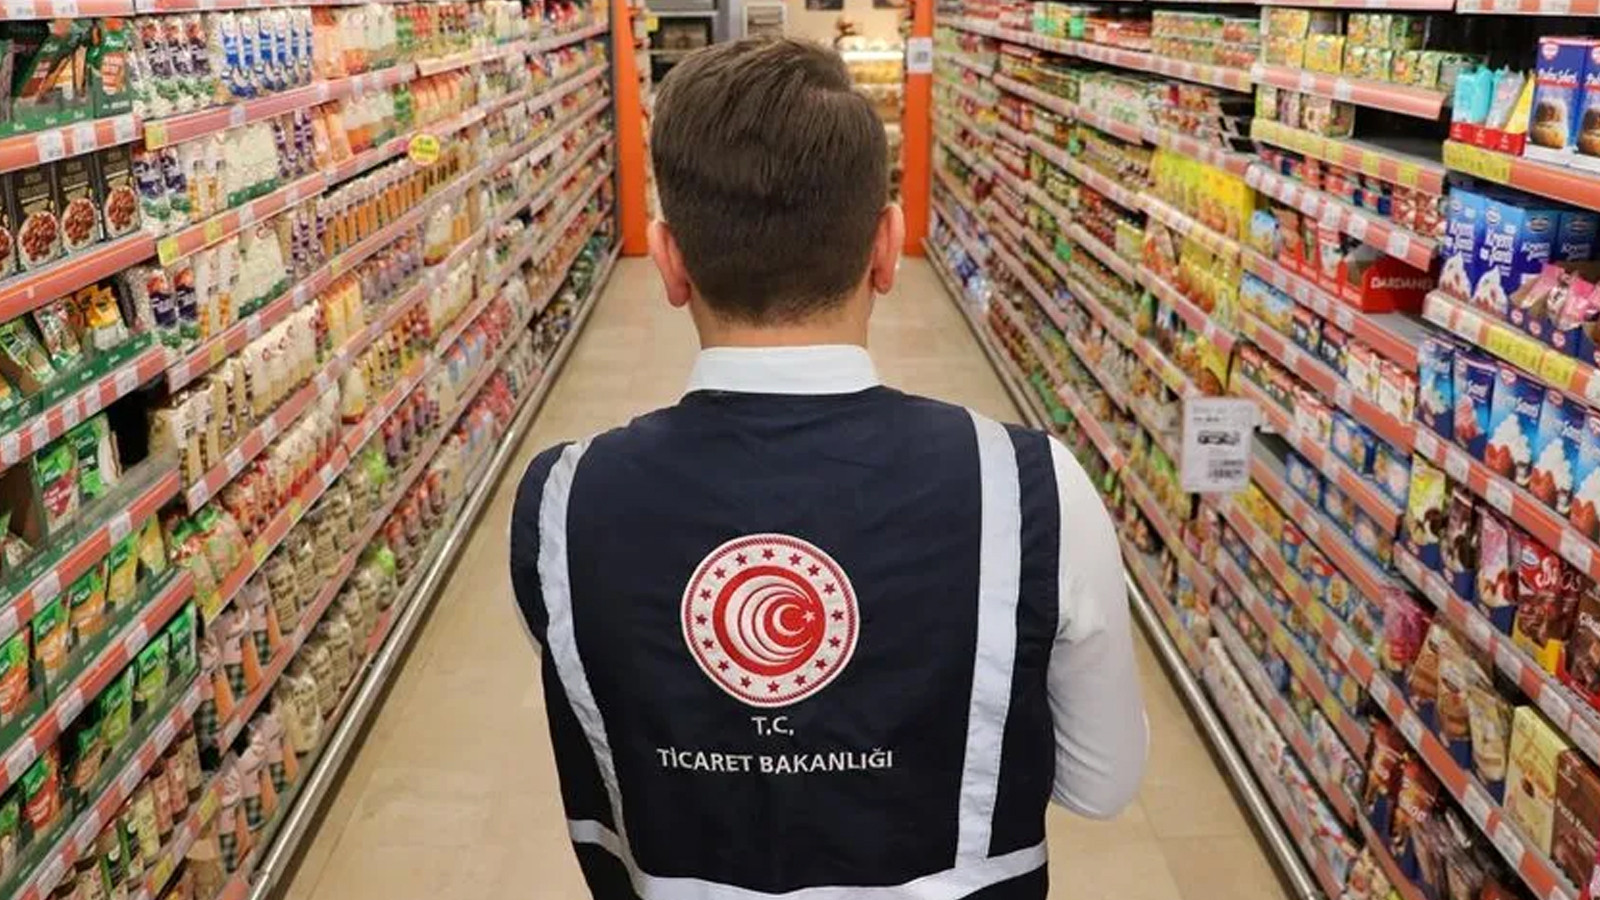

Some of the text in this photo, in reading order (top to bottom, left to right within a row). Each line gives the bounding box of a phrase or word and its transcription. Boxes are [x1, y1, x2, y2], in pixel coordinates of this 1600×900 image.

[751, 716, 795, 736] T.C.
[657, 746, 893, 774] TİCARET BAKANLIĞI
